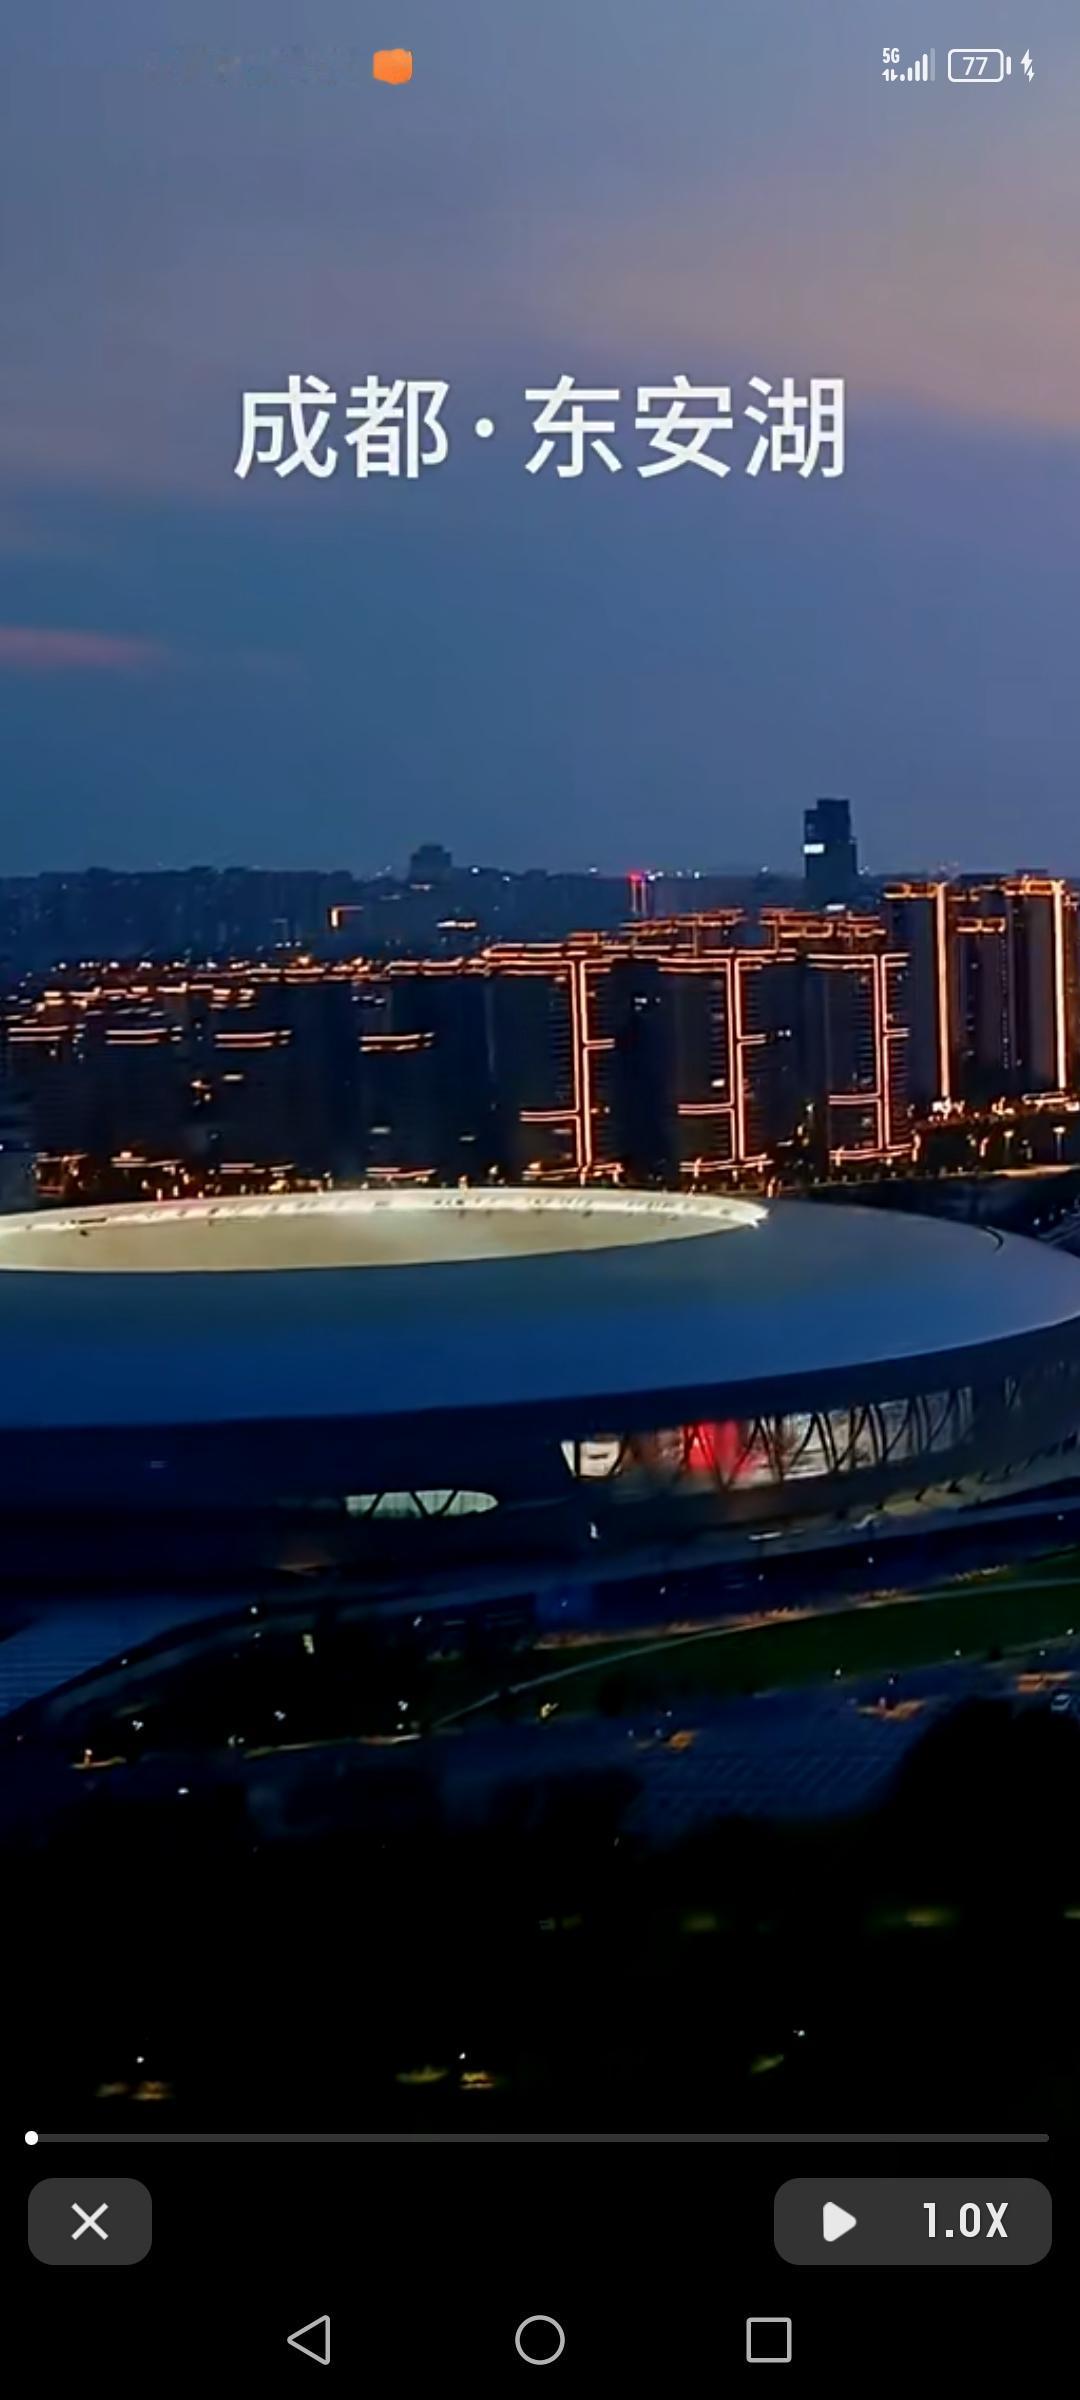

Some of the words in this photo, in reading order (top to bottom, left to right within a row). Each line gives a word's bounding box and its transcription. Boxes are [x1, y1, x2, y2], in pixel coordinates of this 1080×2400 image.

[882, 47, 900, 64] 5G
[962, 56, 989, 76] 77
[923, 2202, 1009, 2238] 1.0X
